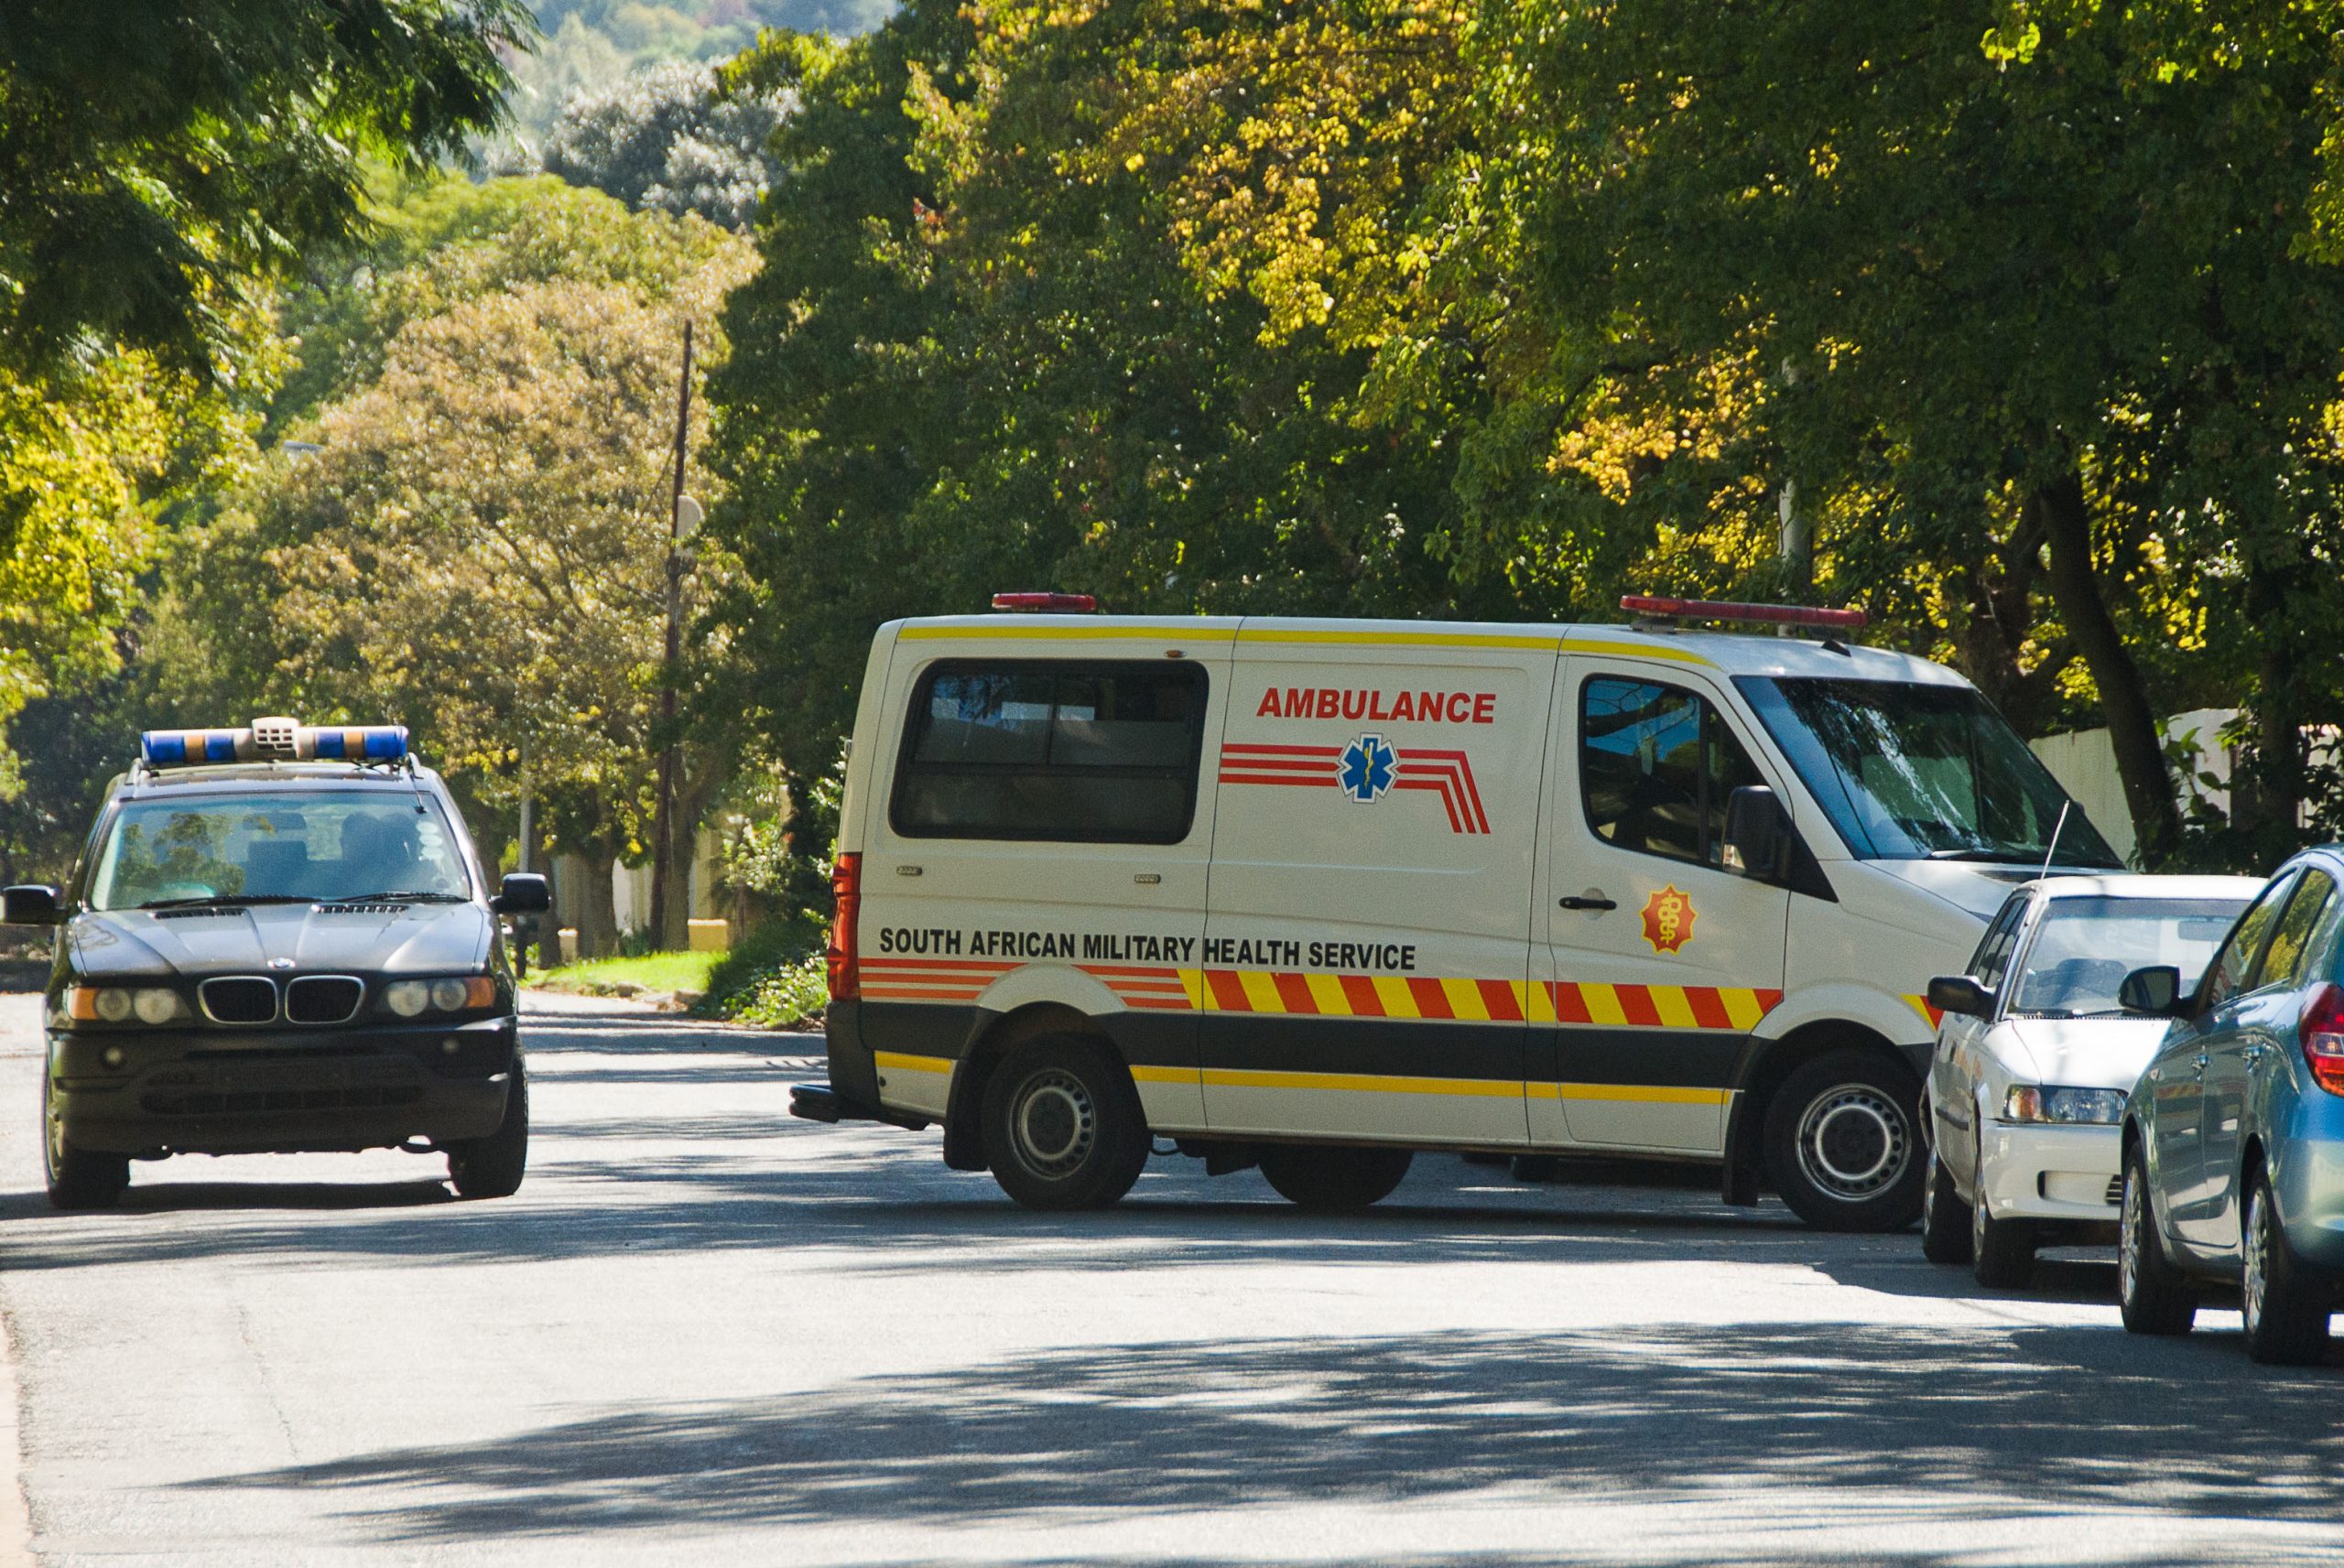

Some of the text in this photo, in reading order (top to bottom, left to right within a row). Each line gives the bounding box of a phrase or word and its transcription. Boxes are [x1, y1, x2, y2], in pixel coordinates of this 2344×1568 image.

[1256, 687, 1495, 723] AMBULANCE
[880, 927, 1416, 970] SOUTH AFRICAN MILITARY HEALTH SERVICE
